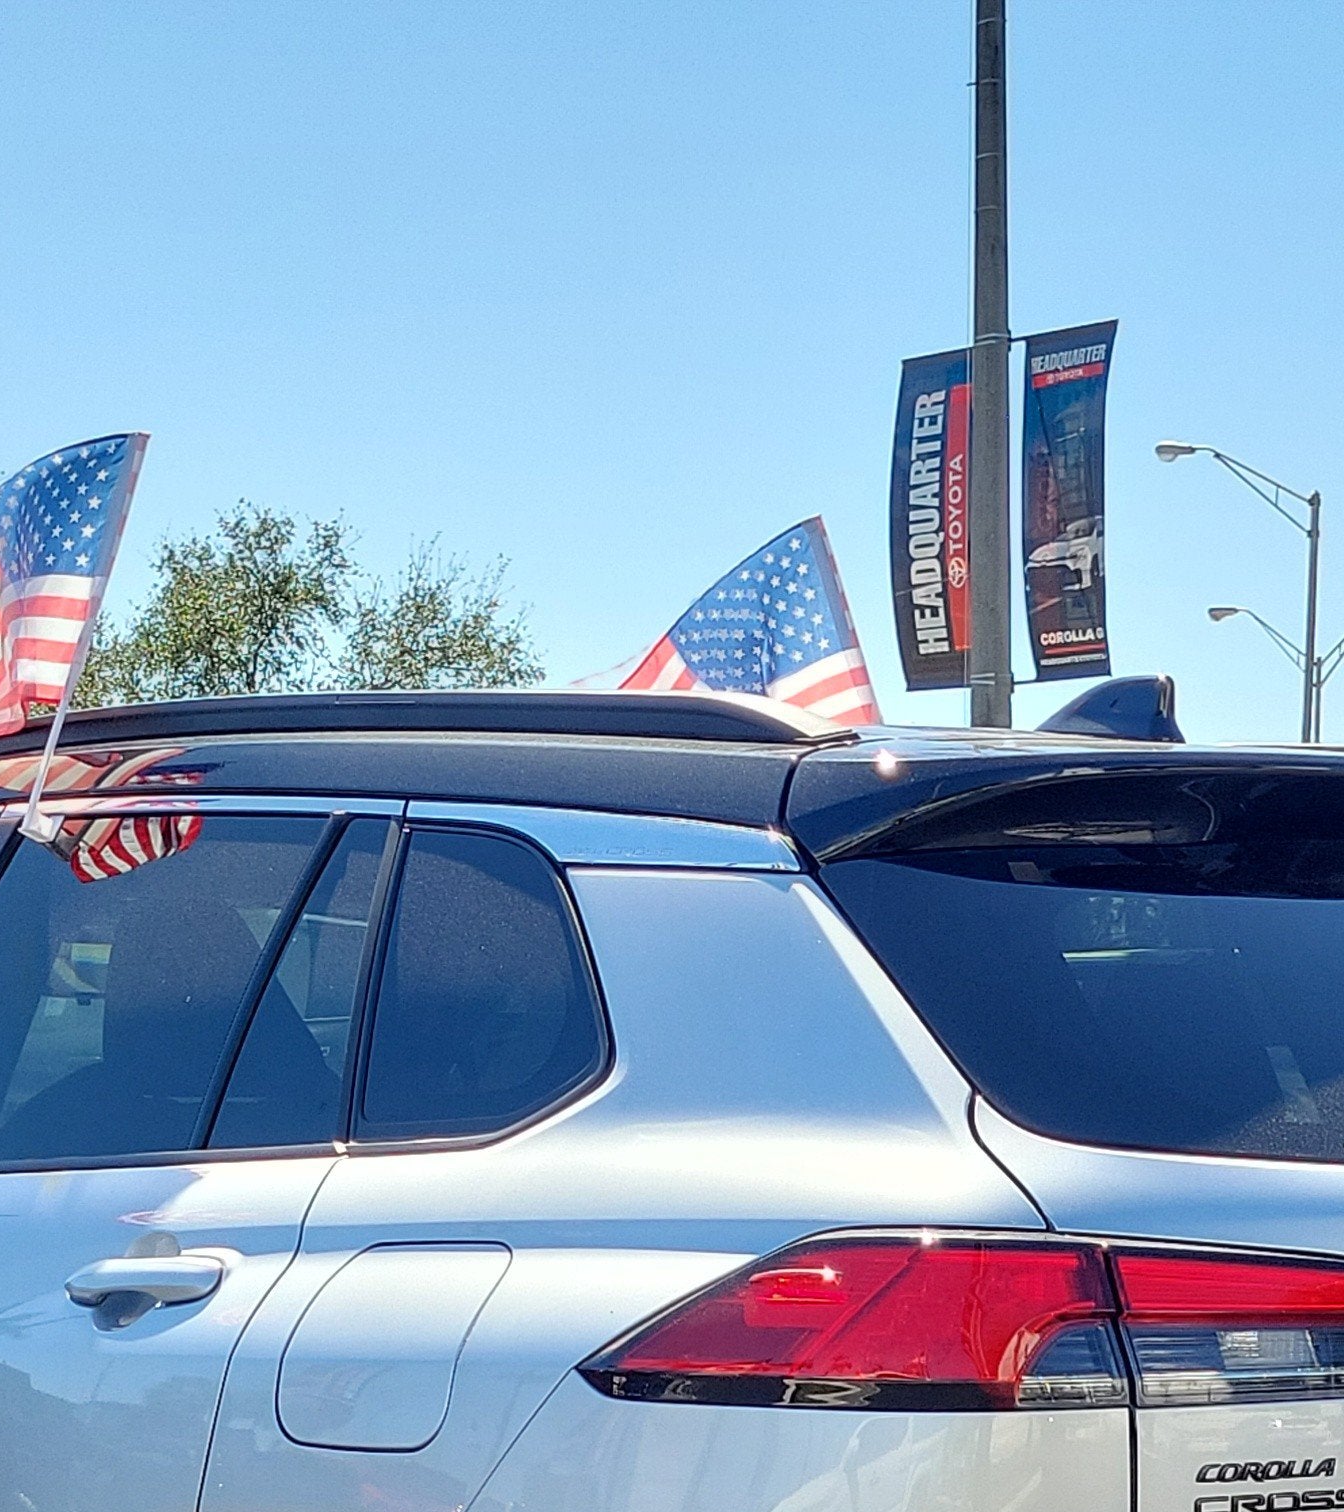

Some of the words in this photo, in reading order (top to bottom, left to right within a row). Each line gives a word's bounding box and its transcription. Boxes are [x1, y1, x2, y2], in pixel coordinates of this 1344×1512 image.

[1031, 344, 1106, 374] HEADQUARTER
[949, 454, 964, 555] TOYOTA
[908, 389, 950, 655] HEADQUARTER
[1040, 628, 1095, 646] COROLLA
[1195, 1457, 1337, 1483] COROLLA
